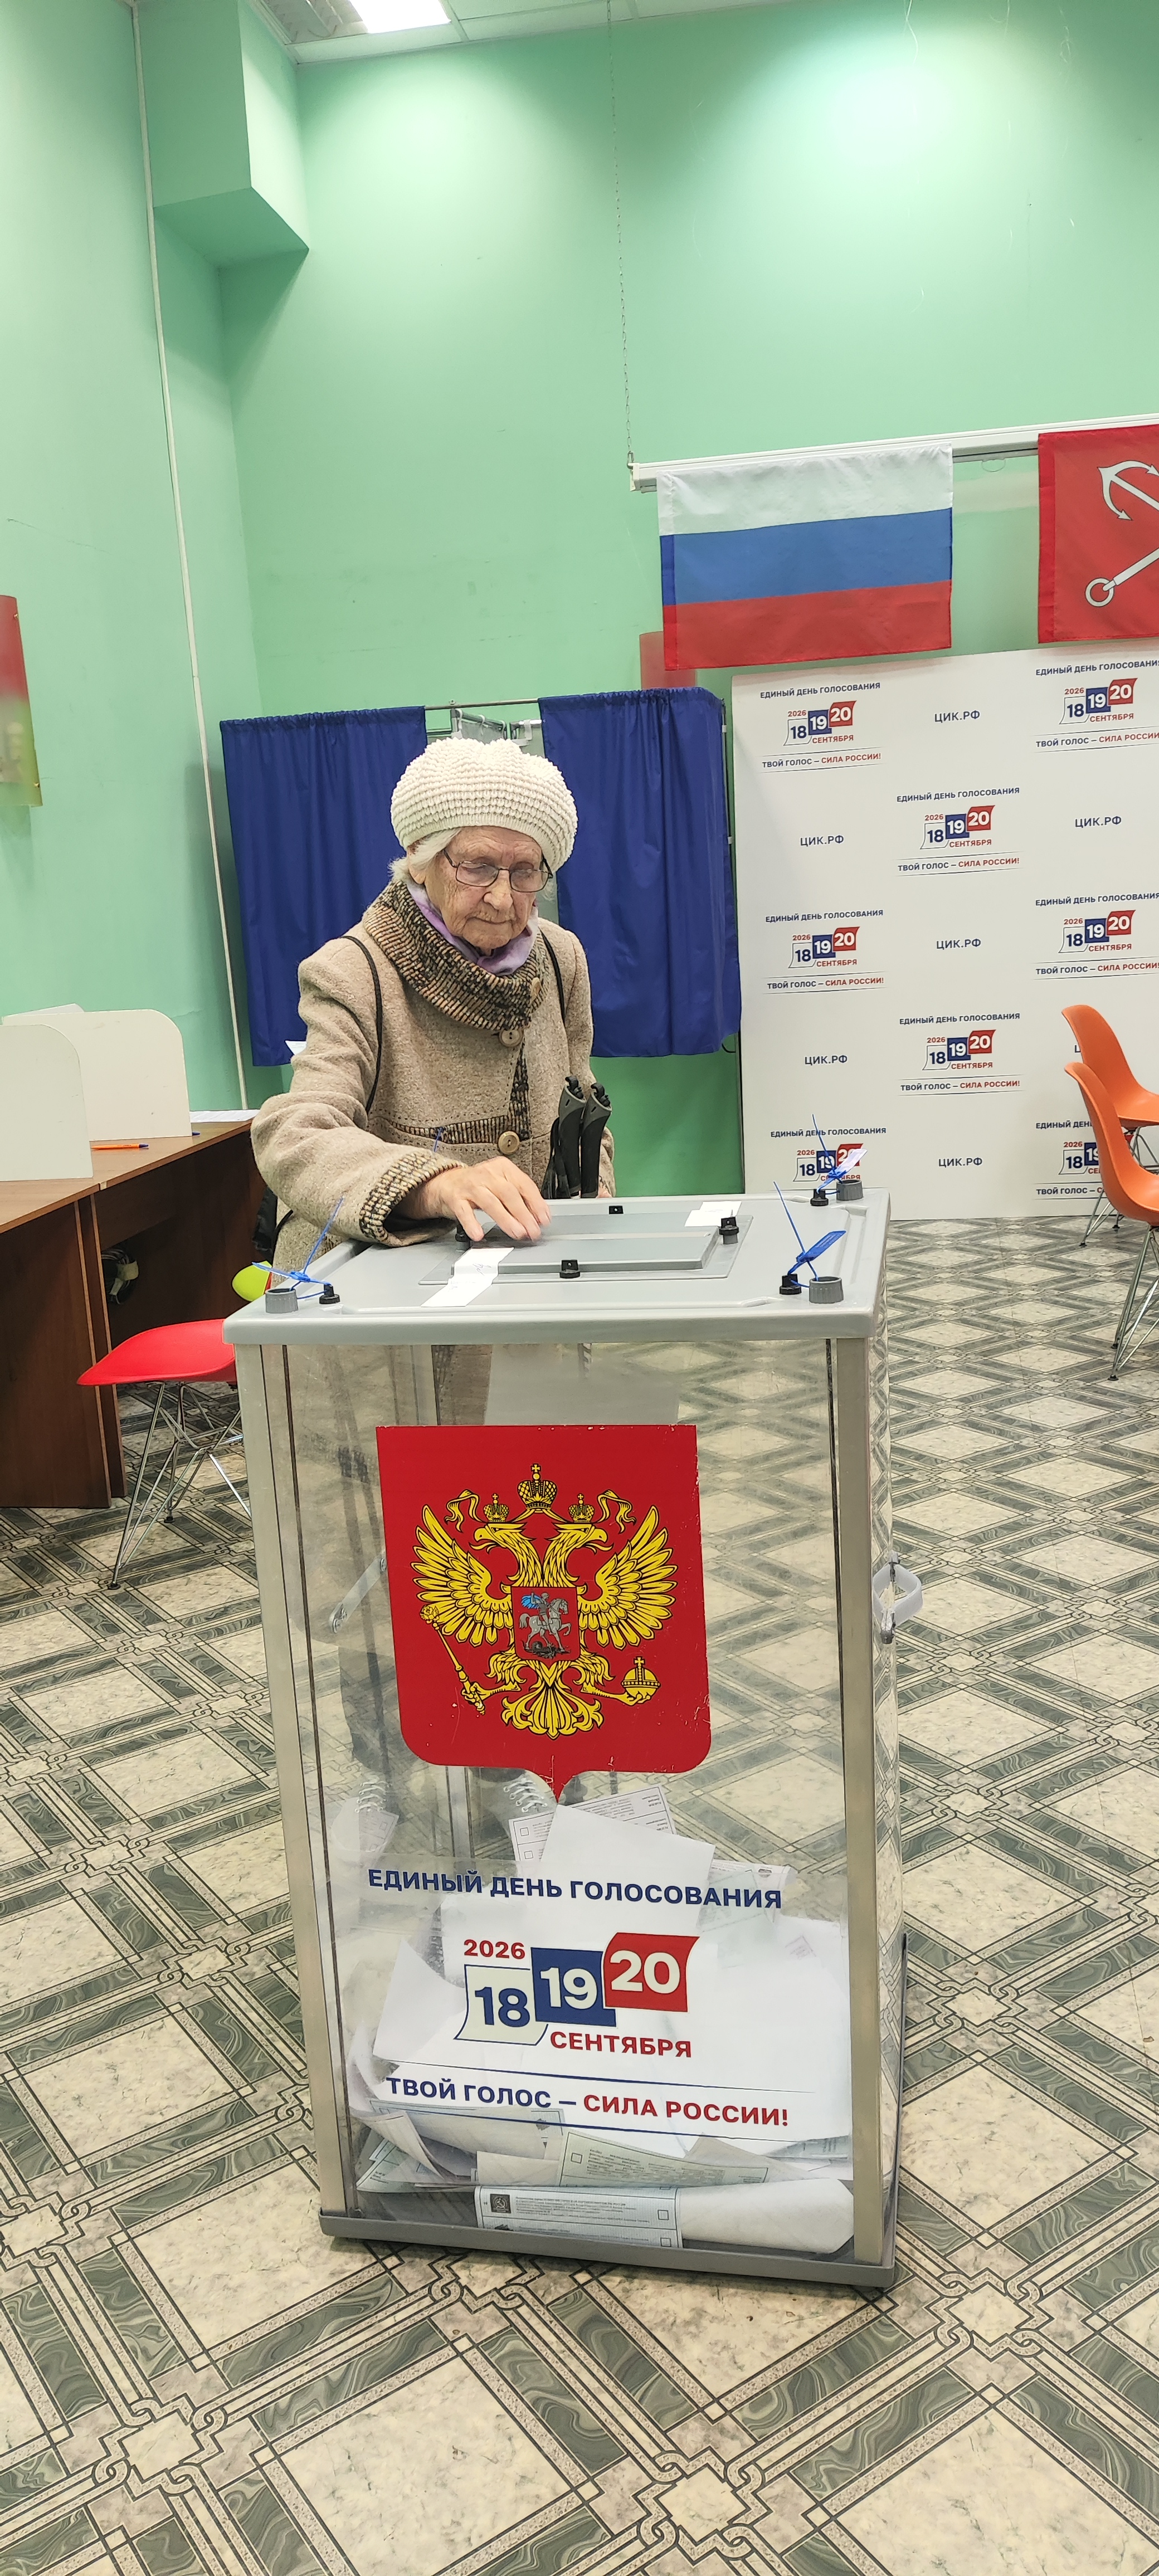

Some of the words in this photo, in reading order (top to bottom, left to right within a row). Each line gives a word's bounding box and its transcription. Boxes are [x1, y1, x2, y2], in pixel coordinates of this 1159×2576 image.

[1035, 665, 1073, 676] ЕДИНЫЙ
[1074, 665, 1097, 674] ДЕНЬ
[760, 689, 795, 699] ЕДИНЫЙ
[796, 687, 818, 697] ДЕНЬ
[820, 682, 880, 694] ГОЛОСОВАНИЯ
[1064, 687, 1084, 695] 2026
[1067, 703, 1084, 718] 18
[1088, 693, 1106, 709] 19
[1109, 684, 1132, 700] 20
[790, 725, 807, 739] 18
[810, 715, 827, 730] 19
[830, 706, 851, 722] 20
[934, 710, 980, 724] ЦИК.РФ
[1089, 713, 1134, 723] СЕНТЯБРЯ
[812, 734, 854, 744] СЕНТЯБРЯ
[1035, 738, 1059, 748] ТВОЙ
[1060, 737, 1089, 746] ГОЛОС
[762, 759, 783, 768] ТВОЙ
[785, 758, 812, 767] ГОЛОС
[845, 753, 881, 762] РОССИИ!
[897, 792, 932, 803] ЕДИНЫЙ
[933, 792, 956, 801] ДЕНЬ
[957, 787, 1020, 798] ГОЛОСОВАНИЯ
[927, 829, 944, 843] 18
[947, 819, 965, 835] 19
[968, 811, 990, 826] 20
[1075, 816, 1122, 828] ЦИК.РФ
[800, 835, 844, 847] ЦИК.РФ
[949, 839, 992, 848] СЕНТЯБРЯ
[897, 862, 920, 871] ТВОЙ
[922, 862, 949, 870] ГОЛОС
[982, 857, 1020, 866] РОССИИ!
[1035, 896, 1072, 907] ЕДИНЫЙ
[1073, 896, 1096, 905] ДЕНЬ
[766, 913, 800, 923] ЕДИНЫЙ
[801, 913, 822, 921] ДЕНЬ
[824, 909, 883, 919] ГОЛОСОВАНИЯ
[1066, 933, 1083, 947] 18
[1087, 924, 1104, 939] 19
[1108, 915, 1130, 931] 20
[795, 949, 811, 963] 18
[814, 940, 831, 954] 19
[834, 932, 855, 947] 20
[936, 938, 981, 950] ЦИК.РФ
[1088, 943, 1132, 952] СЕНТЯБРЯ
[816, 959, 857, 967] СЕНТЯБРЯ
[1035, 966, 1058, 975] ТВОЙ
[767, 980, 788, 989] ТВОЙ
[899, 1016, 934, 1026] ЕДИНЫЙ
[936, 1016, 957, 1024] ДЕНЬ
[959, 1013, 1020, 1022] ГОЛОСОВАНИЯ
[929, 1051, 946, 1065] 18
[949, 1043, 966, 1057] 19
[970, 1035, 991, 1050] 20
[805, 1055, 848, 1066] ЦИК.РФ
[900, 1082, 922, 1091] ТВОЙ
[1035, 1120, 1072, 1130] ЕДИНЫЙ
[770, 1129, 804, 1138] ЕДИНЫЙ
[799, 1163, 816, 1177] 18
[817, 1155, 835, 1169] 19
[938, 1157, 983, 1168] ЦИК.РФ
[1065, 1156, 1083, 1169] 18
[1035, 1187, 1059, 1195] ТВОЙ
[367, 1866, 483, 1894] ЕДИНЫЙ
[489, 1875, 563, 1899] ДЕНЬ
[569, 1880, 782, 1910] ГОЛОСОВАНИЯ
[463, 1938, 526, 1960] 2026
[474, 1985, 531, 2028] 18
[539, 1967, 598, 2010] 19
[609, 1949, 681, 1994] 20
[549, 2031, 692, 2058] СЕНТЯБРЯ
[385, 2076, 456, 2101] ТВОЙ
[462, 2084, 552, 2110] ГОЛОС
[583, 2094, 659, 2118] СИЛА
[665, 2100, 788, 2127] РОССИИ!
